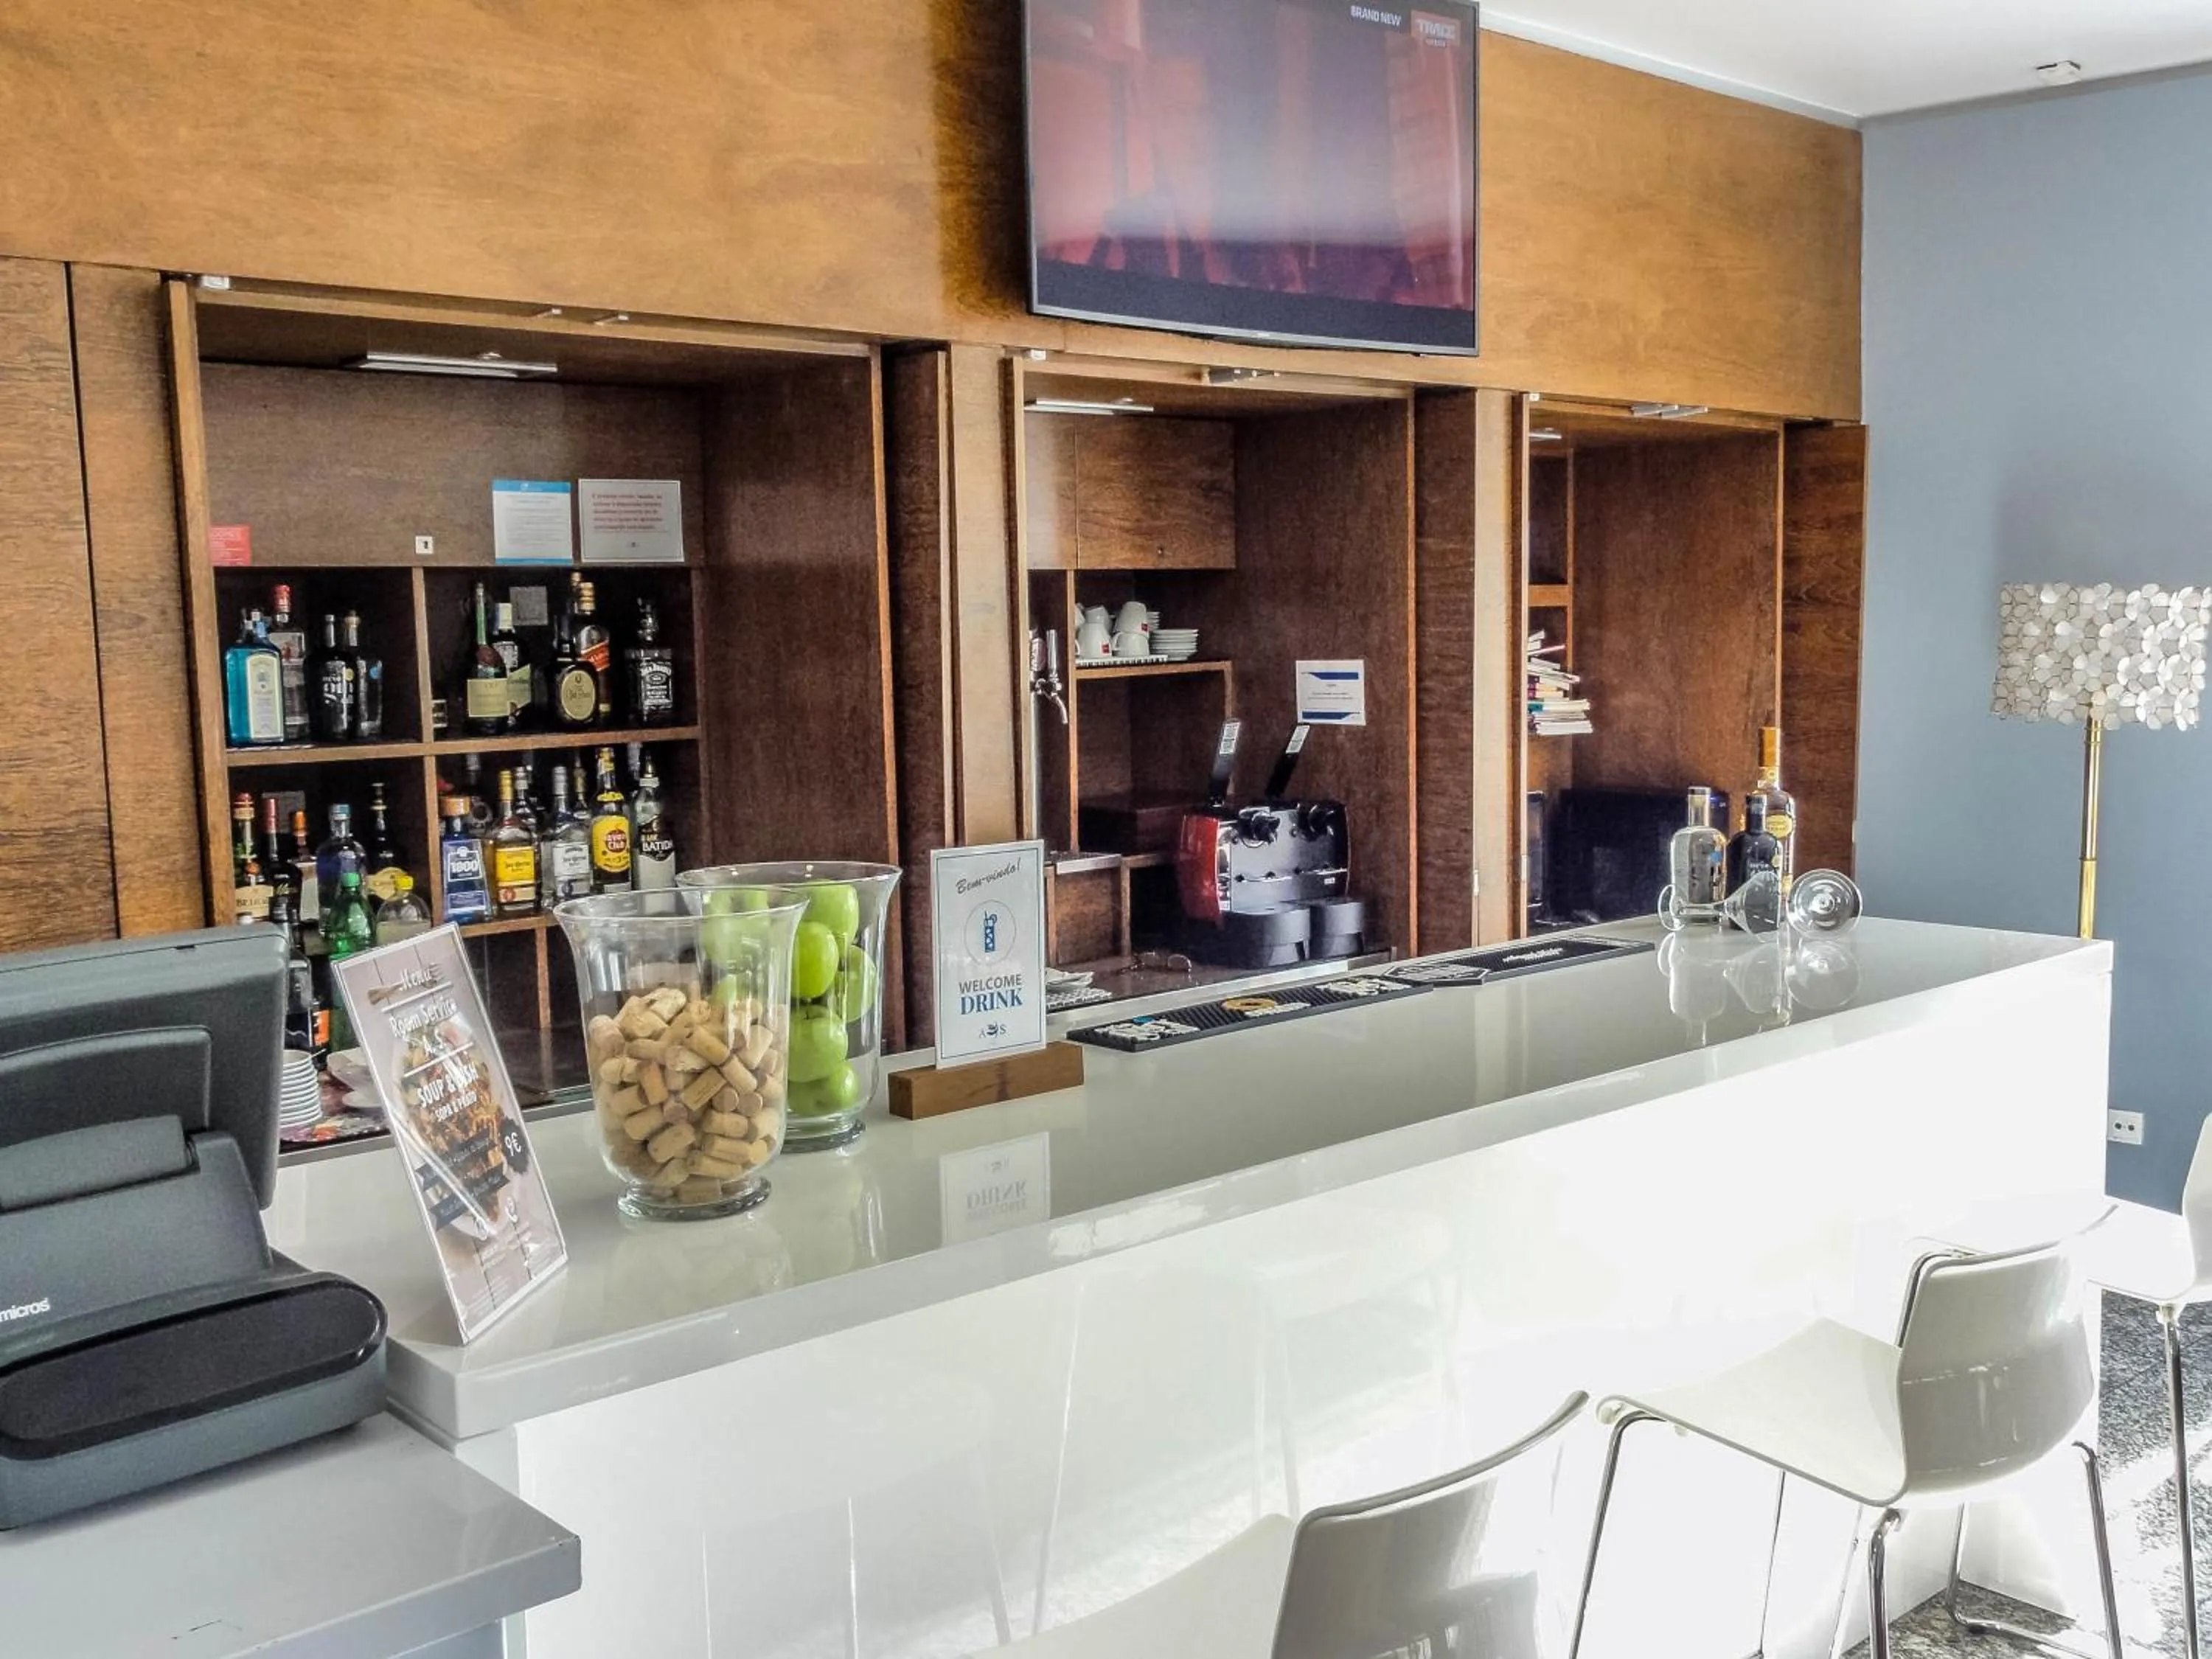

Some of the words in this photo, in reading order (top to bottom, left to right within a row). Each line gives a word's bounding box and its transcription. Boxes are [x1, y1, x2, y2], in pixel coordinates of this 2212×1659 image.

[1350, 5, 1380, 22] BRAND
[1380, 12, 1402, 27] NEW
[955, 855, 1021, 894] Bem-vindo!
[399, 968, 432, 991] Menu
[959, 973, 1022, 994] WELCOME
[961, 988, 1023, 1015] DRINK
[389, 1014, 422, 1040] Room
[420, 996, 458, 1026] Service
[417, 1079, 444, 1107] SOUP
[504, 1132, 521, 1157] 9€
[0, 1299, 51, 1323] micros
